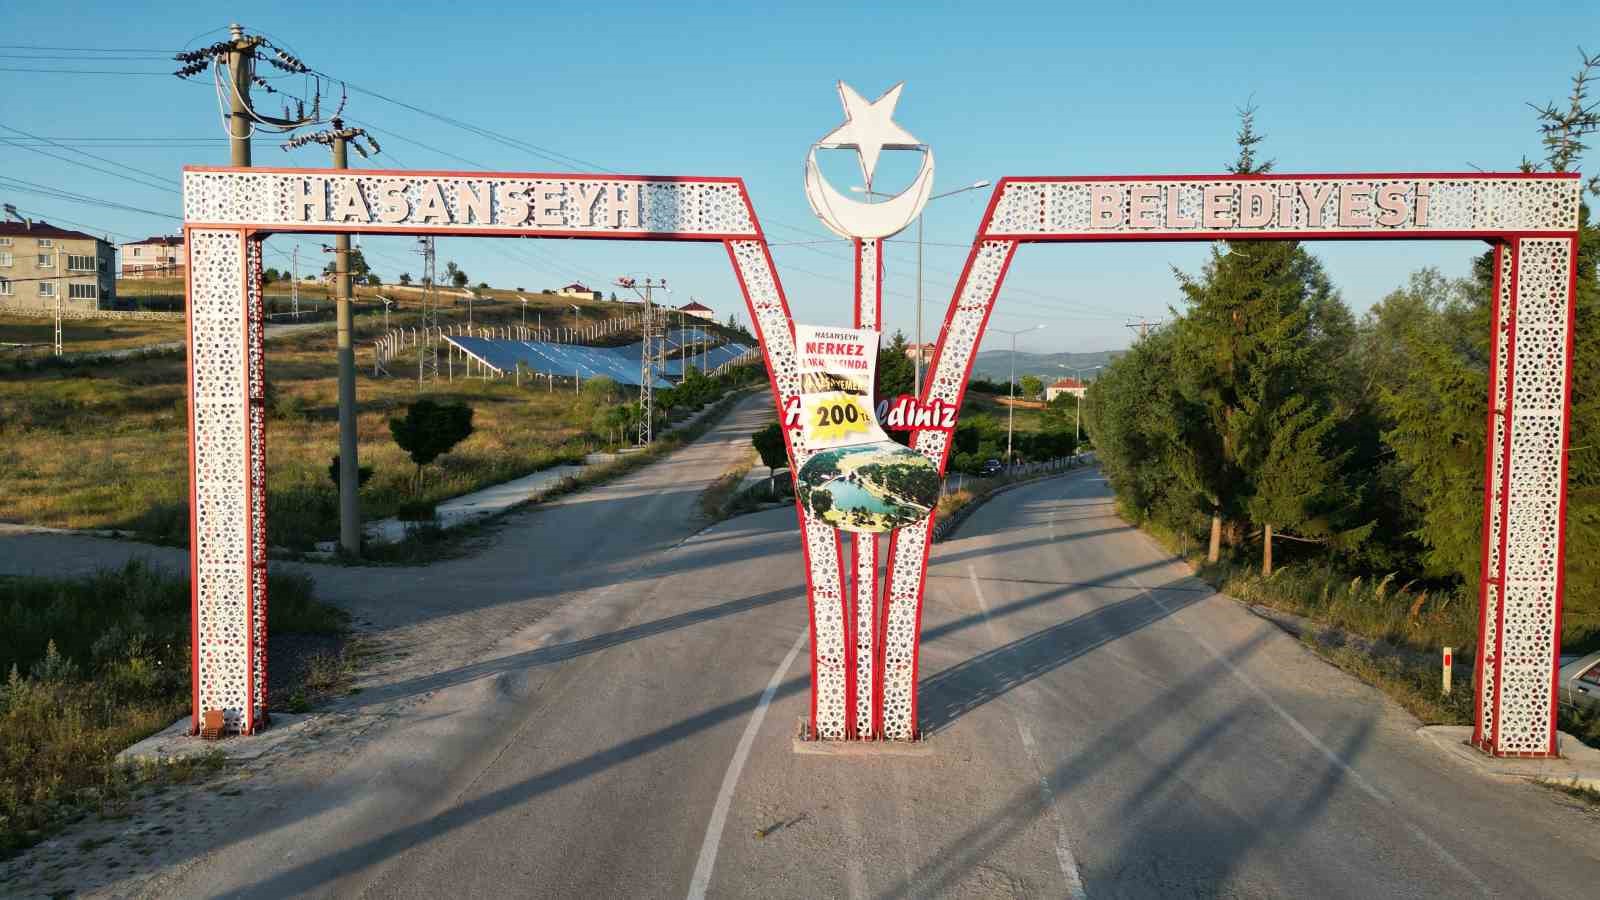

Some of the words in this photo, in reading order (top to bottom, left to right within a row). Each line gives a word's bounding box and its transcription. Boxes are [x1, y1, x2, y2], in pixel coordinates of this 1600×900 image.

[296, 179, 641, 228] HASANSEYH
[806, 342, 864, 356] MERKEZ
[817, 404, 858, 427] 200
